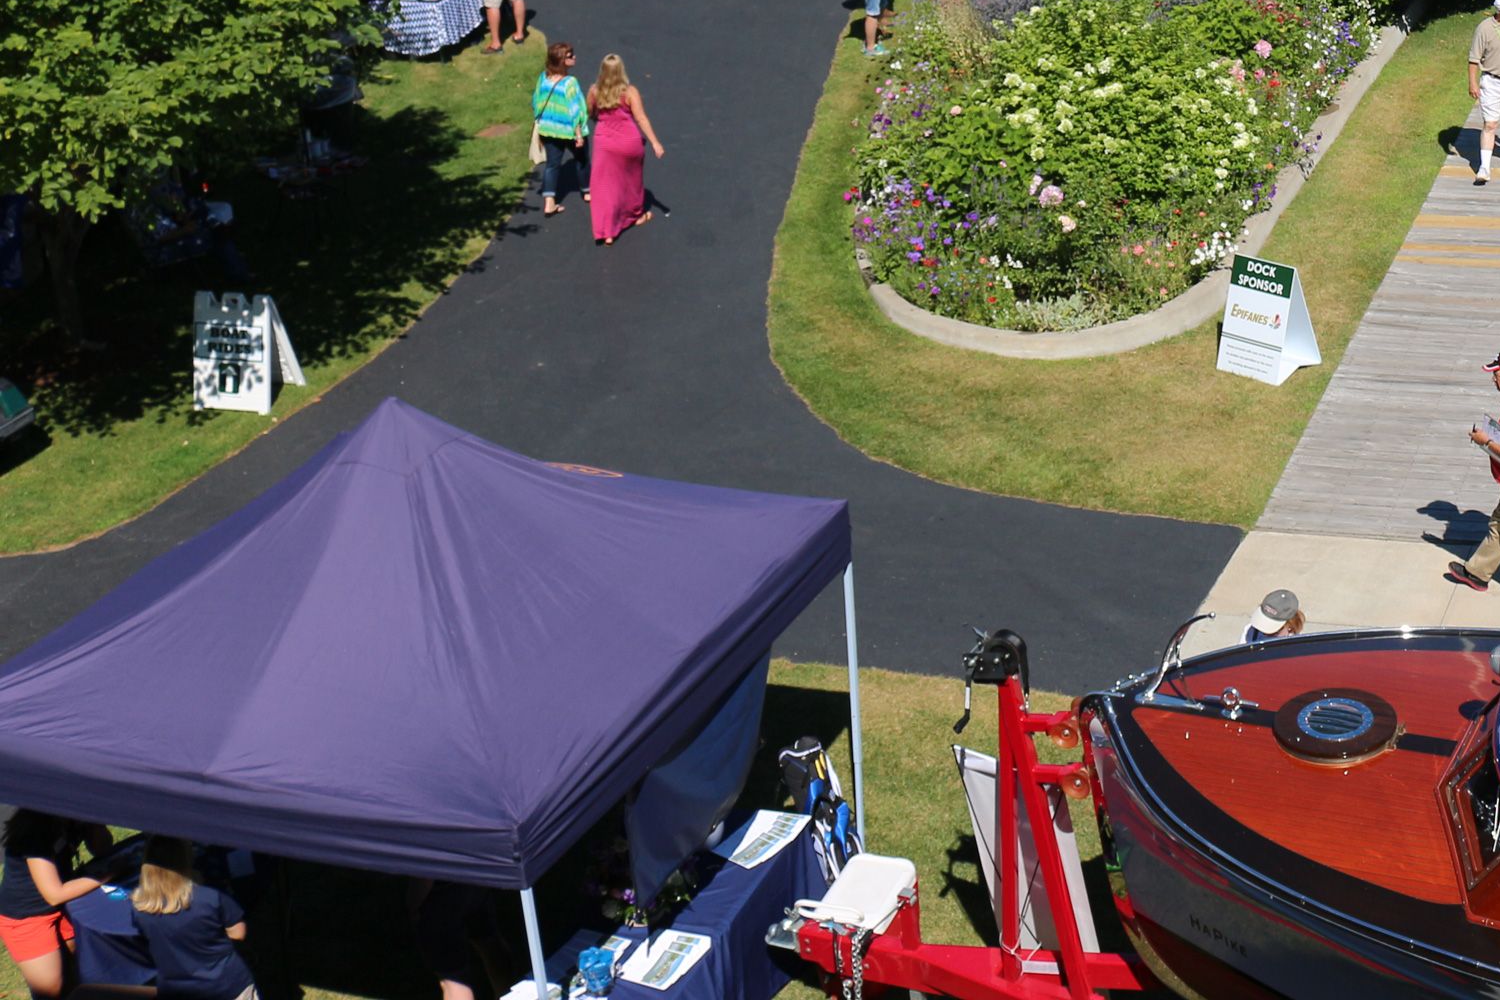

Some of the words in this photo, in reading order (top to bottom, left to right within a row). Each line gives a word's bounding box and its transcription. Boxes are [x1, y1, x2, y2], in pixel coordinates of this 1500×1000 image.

[1246, 260, 1277, 278] DOCK
[1237, 273, 1284, 295] SPONSOR
[210, 327, 249, 339] BOAT
[207, 341, 252, 354] RIDES
